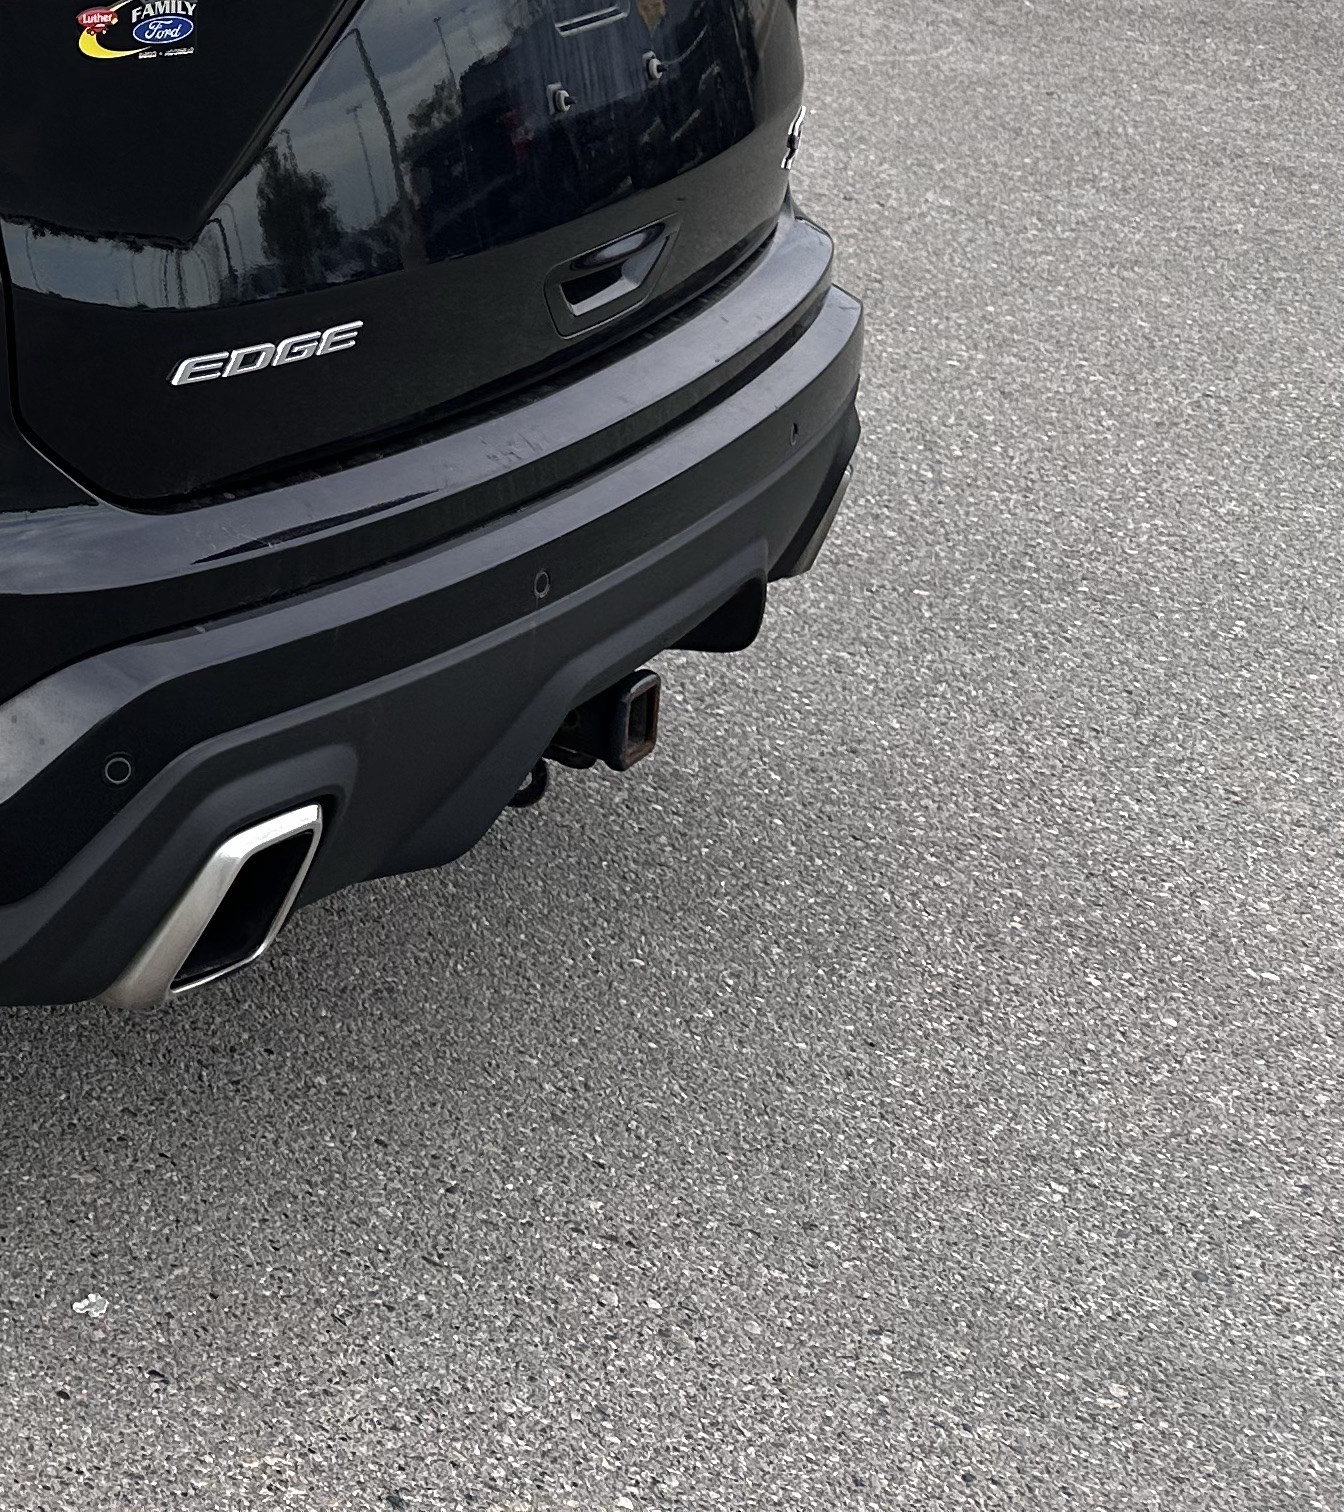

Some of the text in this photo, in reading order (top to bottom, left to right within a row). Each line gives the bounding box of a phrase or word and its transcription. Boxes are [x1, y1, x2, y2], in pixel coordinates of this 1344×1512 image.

[82, 13, 113, 24] Luther
[131, 0, 197, 22] FAMILY
[144, 19, 183, 40] Ford
[169, 318, 365, 387] EDGE
